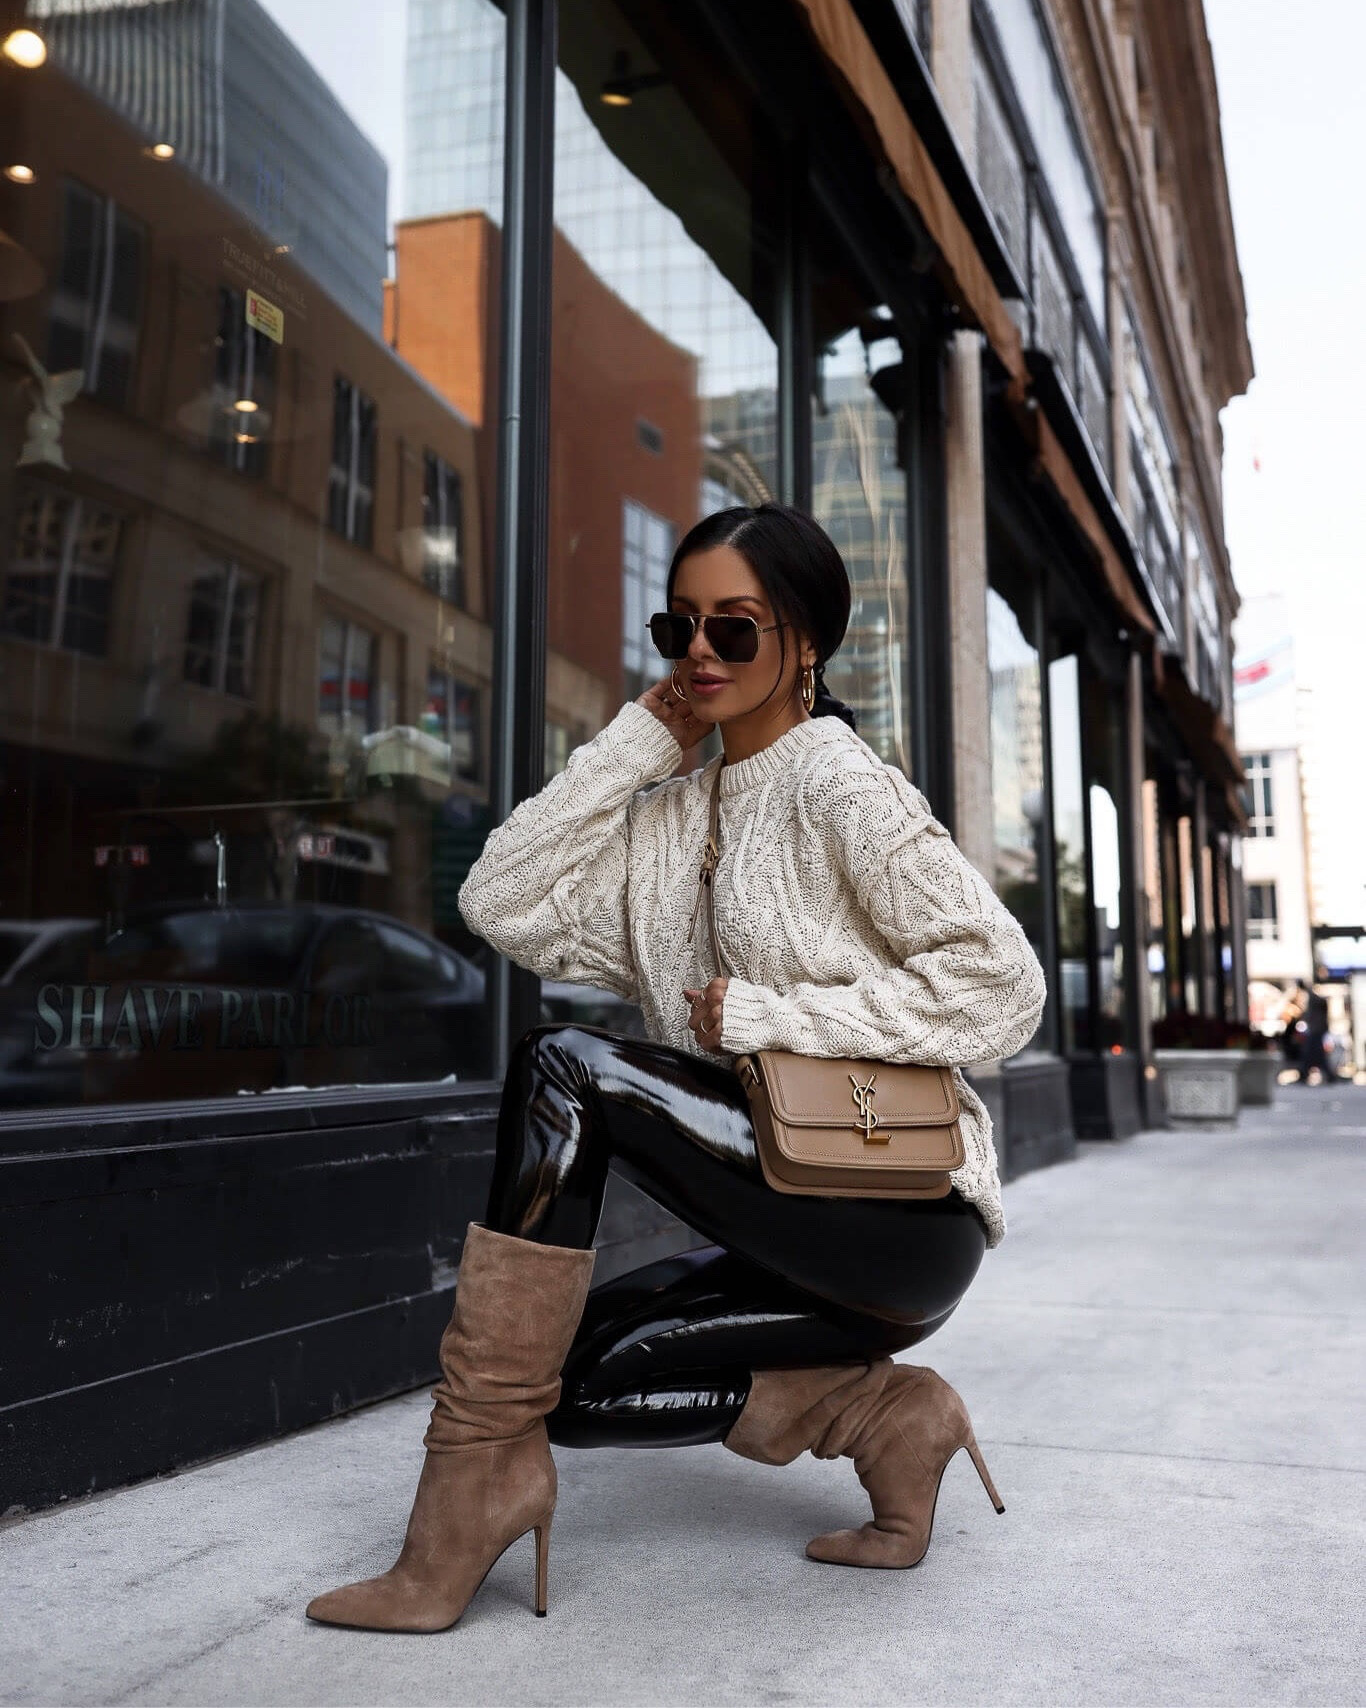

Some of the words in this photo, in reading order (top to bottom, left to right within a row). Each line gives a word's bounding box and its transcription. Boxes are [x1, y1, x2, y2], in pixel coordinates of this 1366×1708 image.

[33, 983, 204, 1052] SHAVE
[216, 988, 375, 1049] PARLOR
[848, 1073, 891, 1145] YSL
